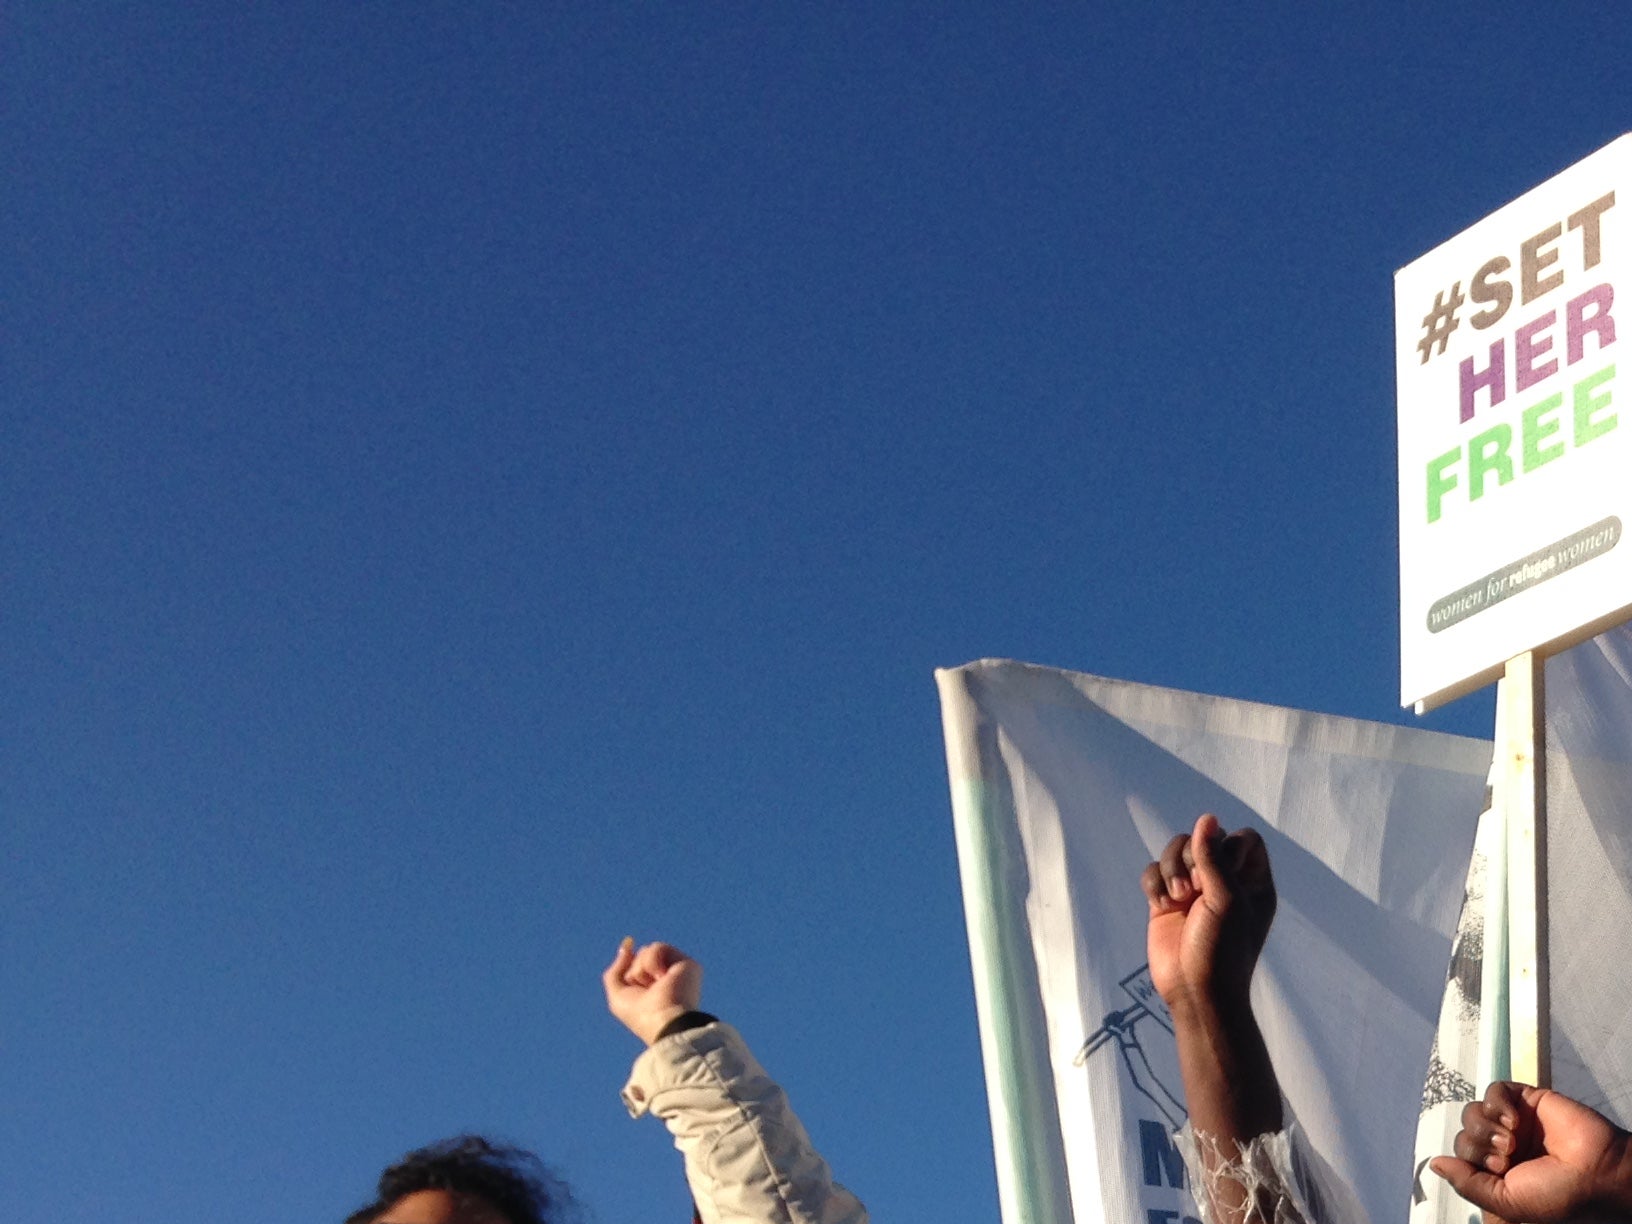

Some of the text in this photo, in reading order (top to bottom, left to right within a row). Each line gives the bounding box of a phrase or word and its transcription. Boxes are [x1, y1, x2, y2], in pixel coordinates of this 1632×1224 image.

[1416, 190, 1616, 366] #SET
[1459, 282, 1617, 424] HER
[1426, 364, 1618, 525] FREE
[1431, 526, 1615, 625] women for refugee women
